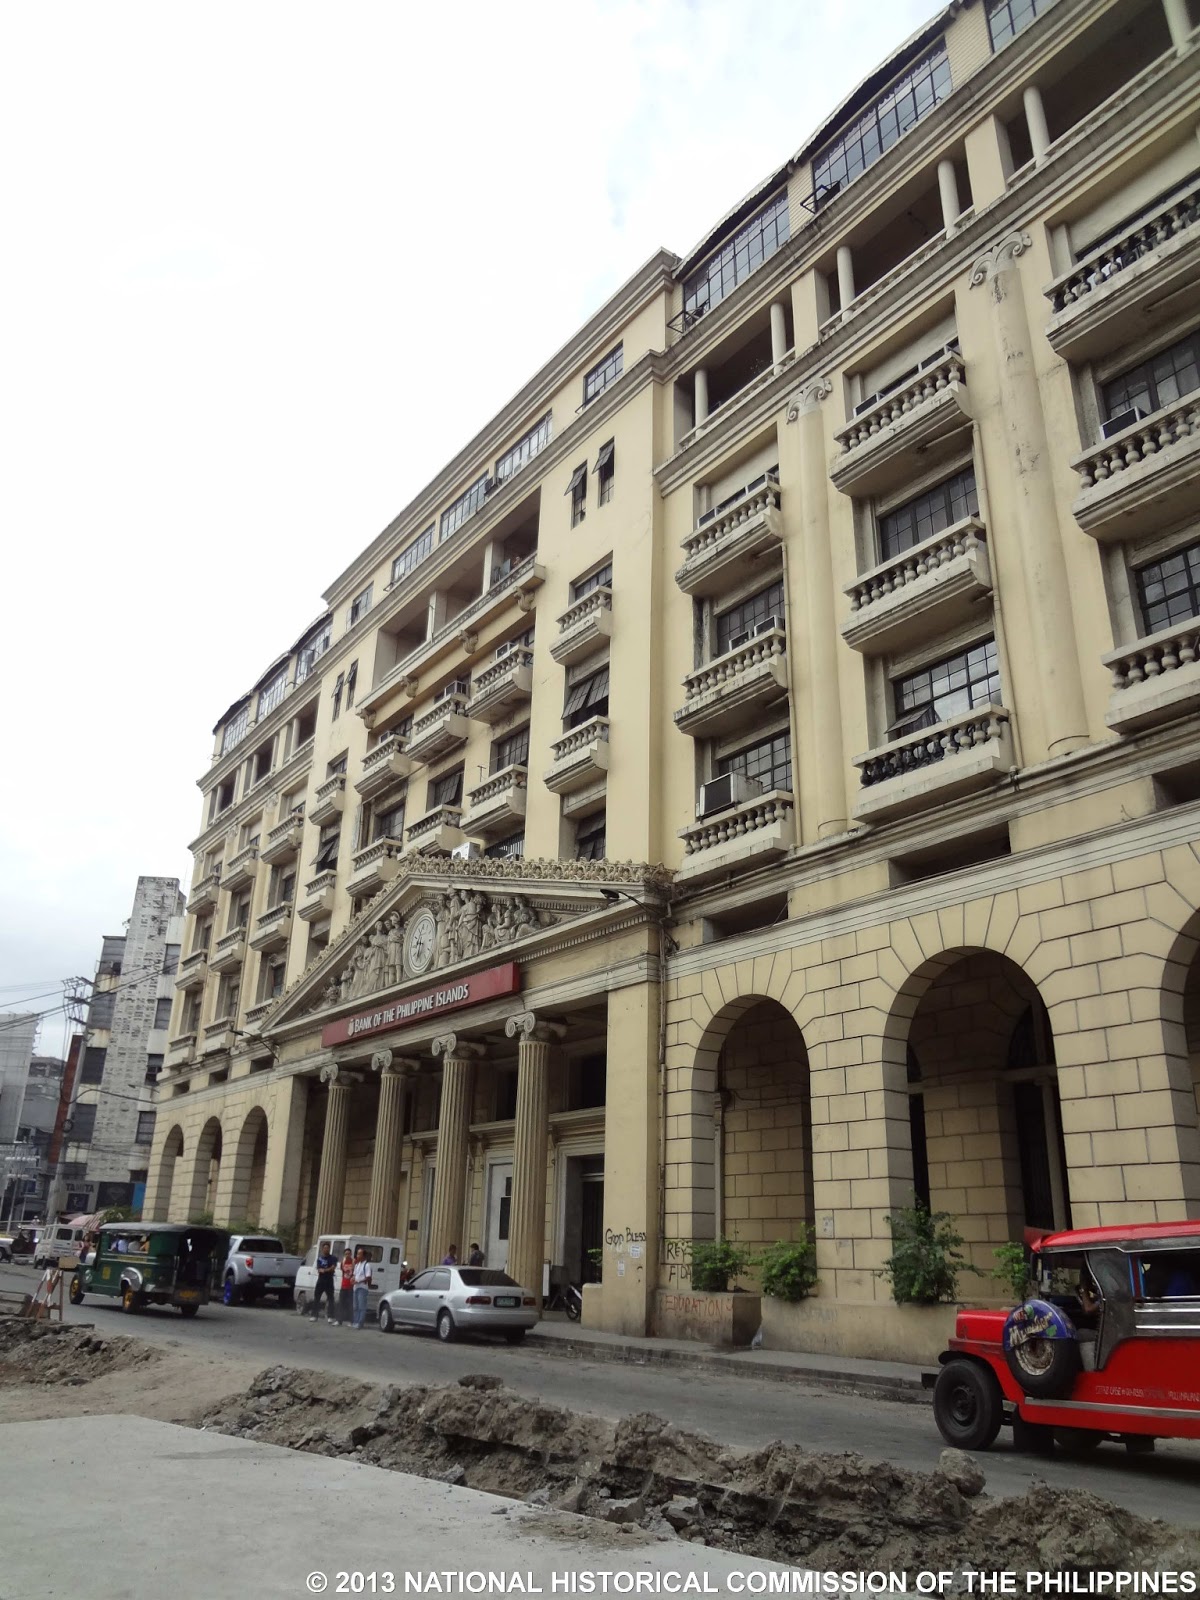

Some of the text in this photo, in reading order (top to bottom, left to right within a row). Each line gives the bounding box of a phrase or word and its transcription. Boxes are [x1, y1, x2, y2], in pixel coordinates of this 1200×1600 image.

[354, 984, 469, 1033] BANK OF THE PHILIPPINE ISLANDS
